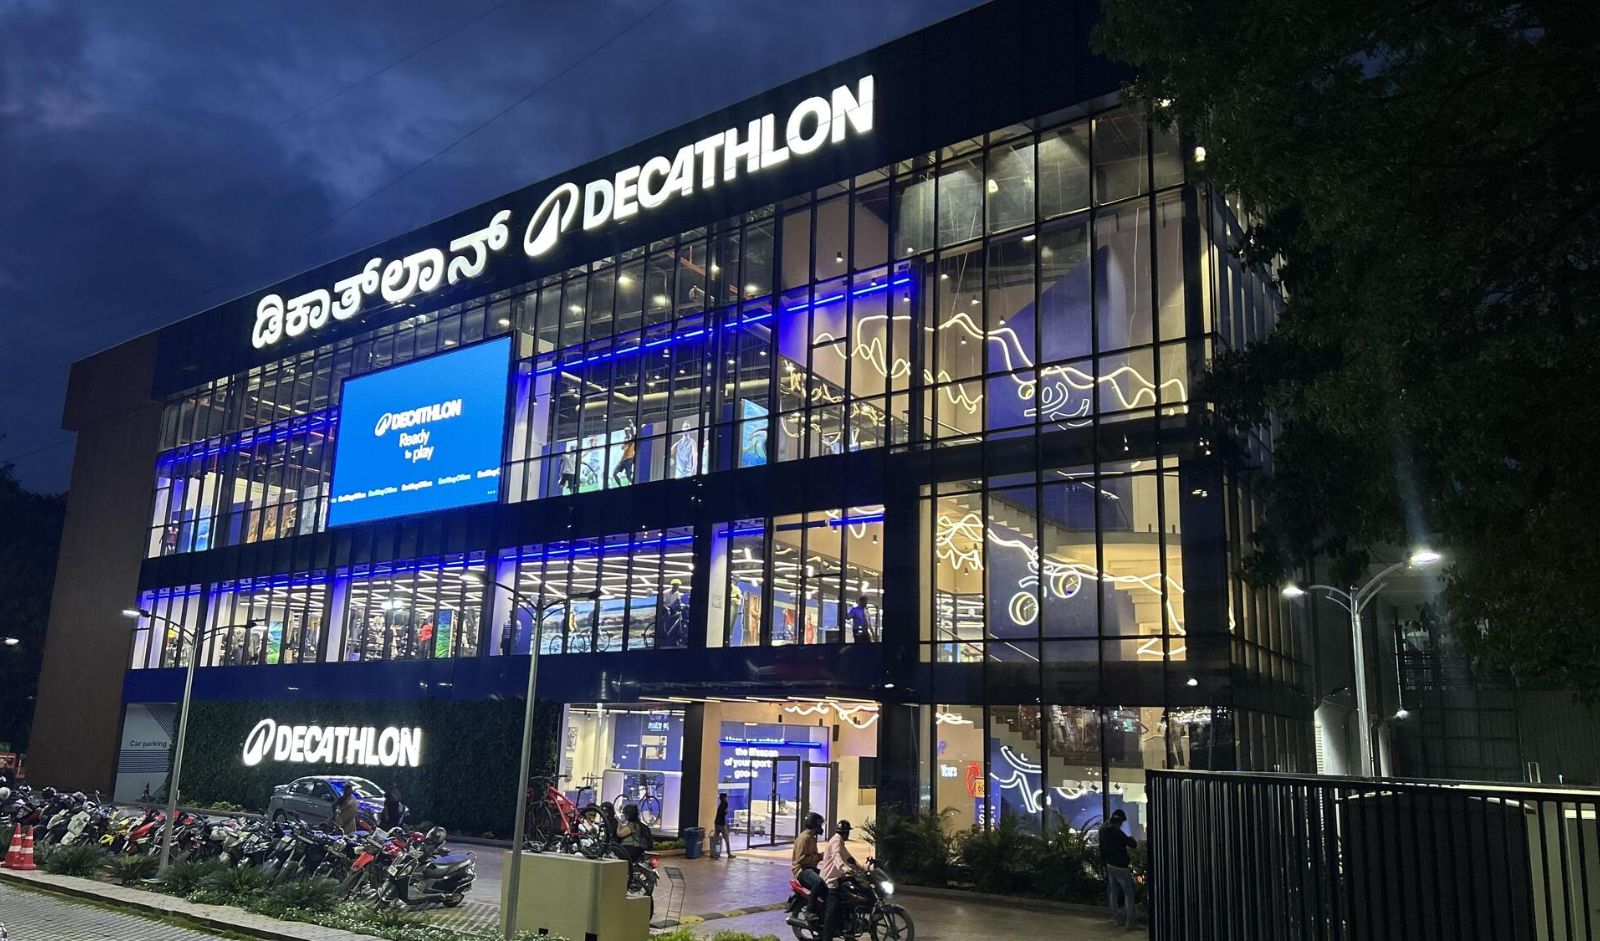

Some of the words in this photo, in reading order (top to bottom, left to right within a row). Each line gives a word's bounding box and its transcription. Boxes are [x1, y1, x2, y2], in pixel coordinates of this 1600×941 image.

[582, 75, 874, 231] DECATHLON
[391, 398, 462, 430] DECATHLON
[399, 428, 430, 448] Ready
[412, 445, 434, 463] play
[143, 740, 167, 748] parking
[274, 725, 422, 767] DECATHLON
[724, 757, 733, 766] of
[733, 759, 751, 768] your
